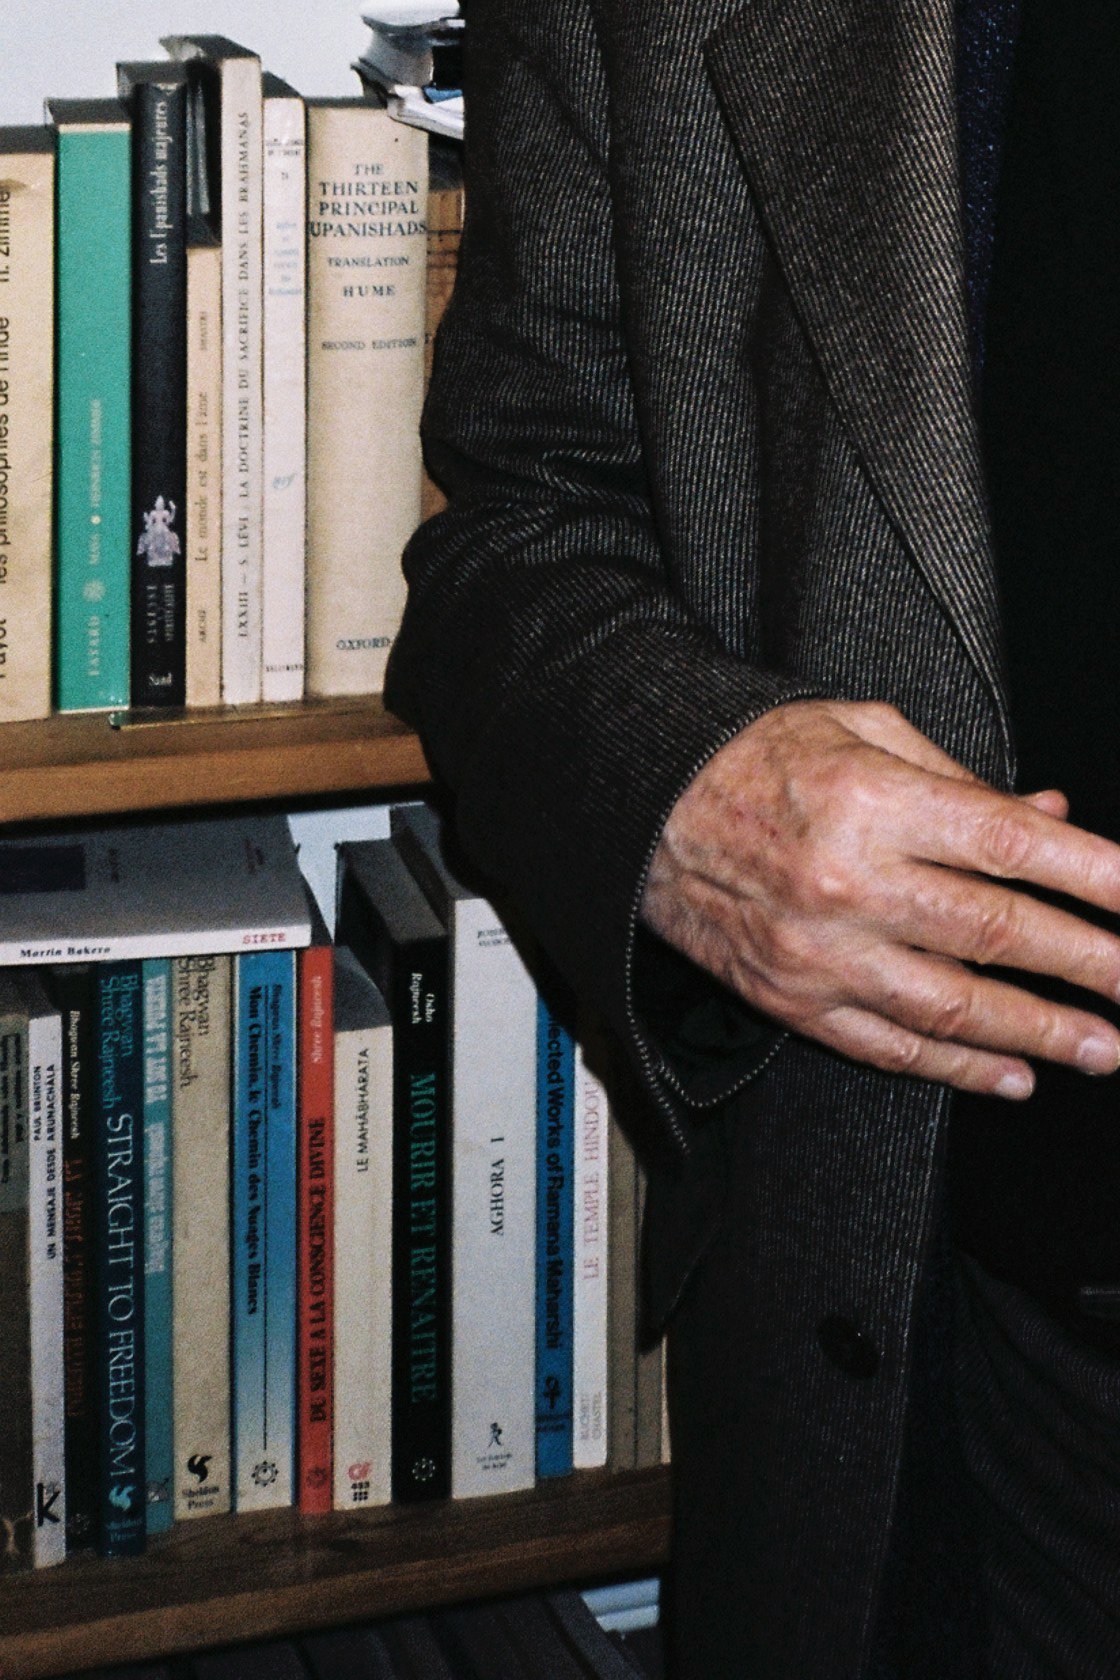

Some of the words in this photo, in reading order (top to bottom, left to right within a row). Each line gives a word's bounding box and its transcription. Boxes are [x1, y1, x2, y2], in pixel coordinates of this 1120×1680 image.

[318, 180, 418, 196] THIRTEEN
[354, 163, 384, 176] THE
[237, 211, 249, 235] LES
[318, 200, 419, 216] PRINCIPAL
[309, 220, 427, 238] UPANISHADS
[148, 243, 169, 264] Les
[237, 242, 249, 281] DANS
[327, 256, 410, 268] TRANSLATION
[343, 285, 397, 298] HUME
[237, 288, 249, 361] SACRIFICE
[372, 337, 417, 351] EDITION
[237, 368, 249, 389] DU
[194, 433, 208, 463] dans
[237, 397, 249, 473] DOCTRINE
[195, 469, 207, 488] est
[238, 480, 249, 498] LA
[194, 494, 208, 539] monde
[194, 547, 208, 562] Le
[335, 636, 391, 651] OXFORD
[242, 931, 286, 945] SIETE
[178, 958, 196, 1006] Shree
[193, 956, 217, 1036] Bhagwan
[408, 972, 424, 1024] Rajneesh
[99, 976, 121, 1029] Shree
[115, 974, 140, 1057] Bhagwan
[248, 985, 263, 1019] Mon
[424, 992, 436, 1023] Osho
[98, 1029, 123, 1109] Rajneesh
[176, 1010, 198, 1089] Rajneesh
[32, 1065, 42, 1112] BRUNTON
[247, 1089, 262, 1104] le
[32, 1116, 42, 1142] PAUL
[409, 1072, 437, 1192] MOURIR
[544, 1088, 565, 1149] Works
[247, 1109, 263, 1169] Chemin
[307, 1117, 326, 1180] DIVINE
[45, 1147, 56, 1181] DESDE
[356, 1155, 370, 1173] LE
[544, 1153, 565, 1174] of
[107, 1112, 136, 1269] STRAIGHT
[247, 1173, 262, 1201] des
[489, 1158, 506, 1236] AGHORA
[46, 1186, 57, 1238] MENSAJE
[409, 1197, 437, 1237] ET
[544, 1176, 565, 1256] Ramana
[583, 1172, 600, 1244] TEMPLE
[46, 1242, 57, 1260] UN
[244, 1205, 262, 1259] Nuages
[308, 1182, 327, 1296] CONSCIENCE
[246, 1263, 262, 1315] Blancs
[583, 1258, 600, 1281] LE
[108, 1275, 135, 1321] TO
[308, 1301, 326, 1324] LA
[544, 1259, 565, 1349] Maharshi
[308, 1346, 326, 1393] SEXE
[108, 1328, 136, 1478] FREEDOM
[308, 1399, 326, 1423] DU
